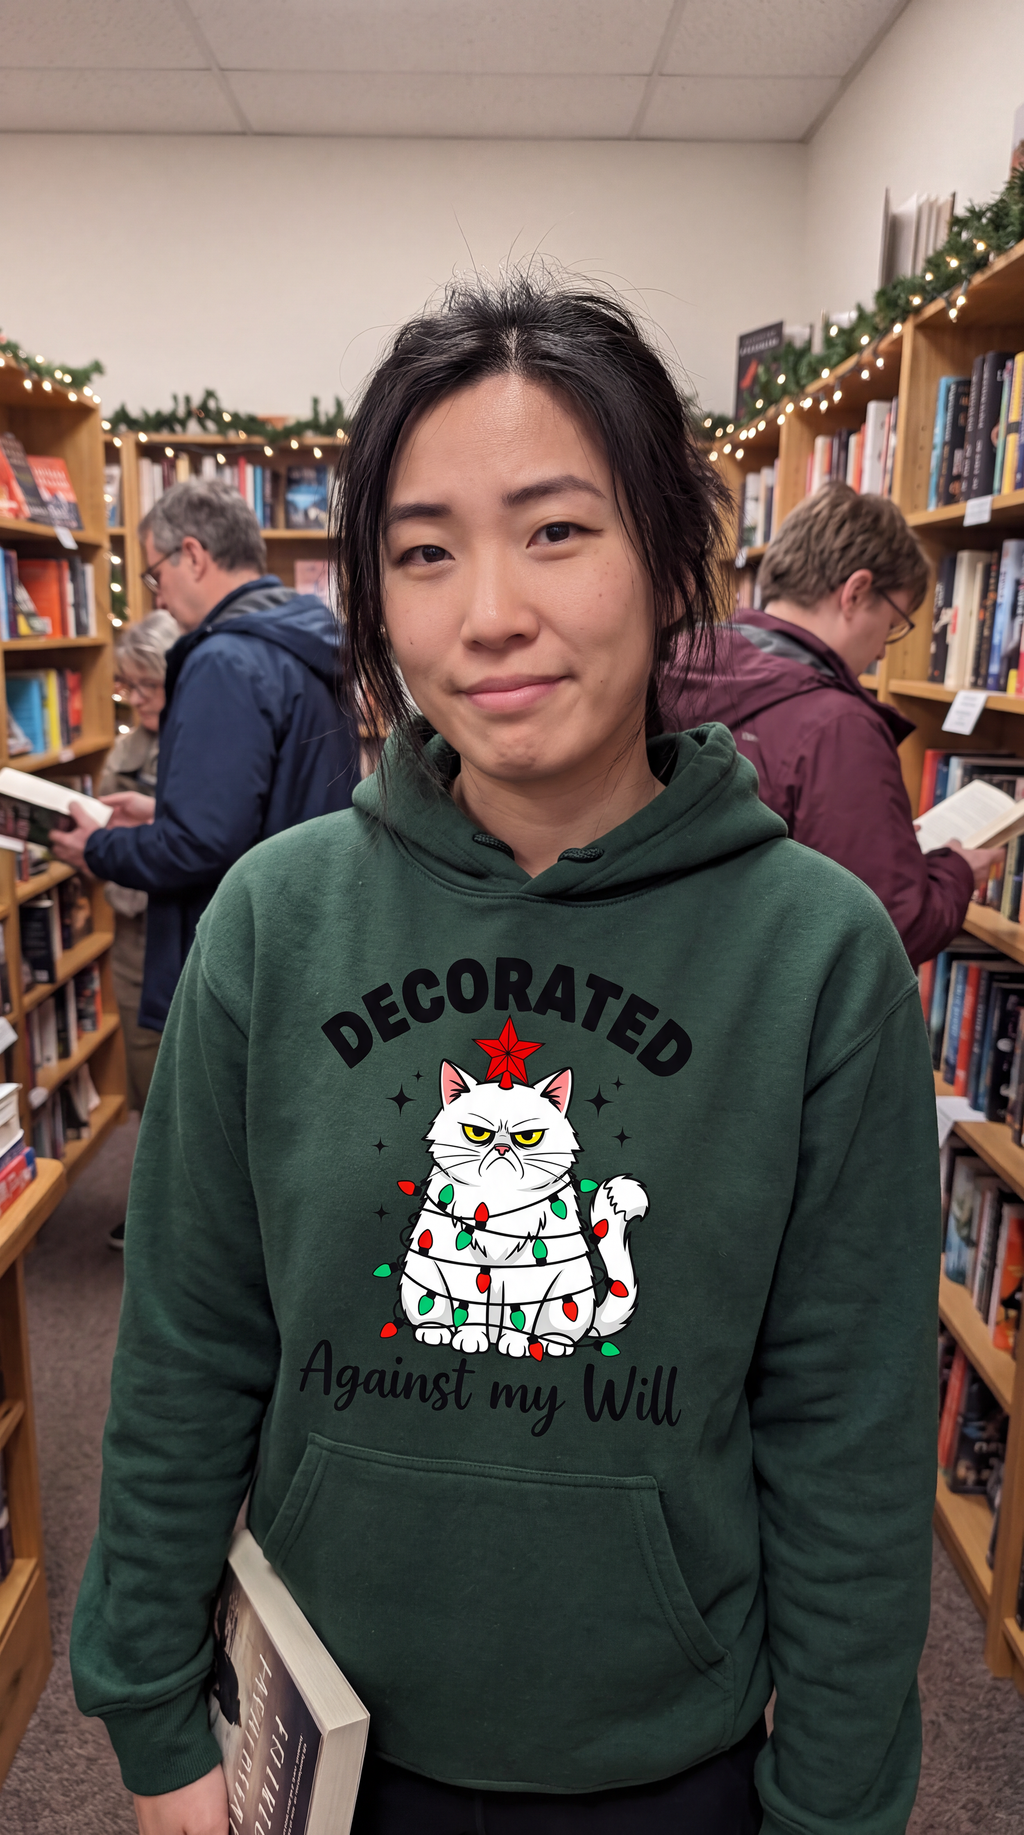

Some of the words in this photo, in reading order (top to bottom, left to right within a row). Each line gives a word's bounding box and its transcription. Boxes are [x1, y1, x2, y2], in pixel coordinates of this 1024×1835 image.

[320, 957, 693, 1077] DECORATED
[299, 1339, 476, 1412] Against
[489, 1380, 566, 1437] my
[583, 1363, 682, 1427] Will
